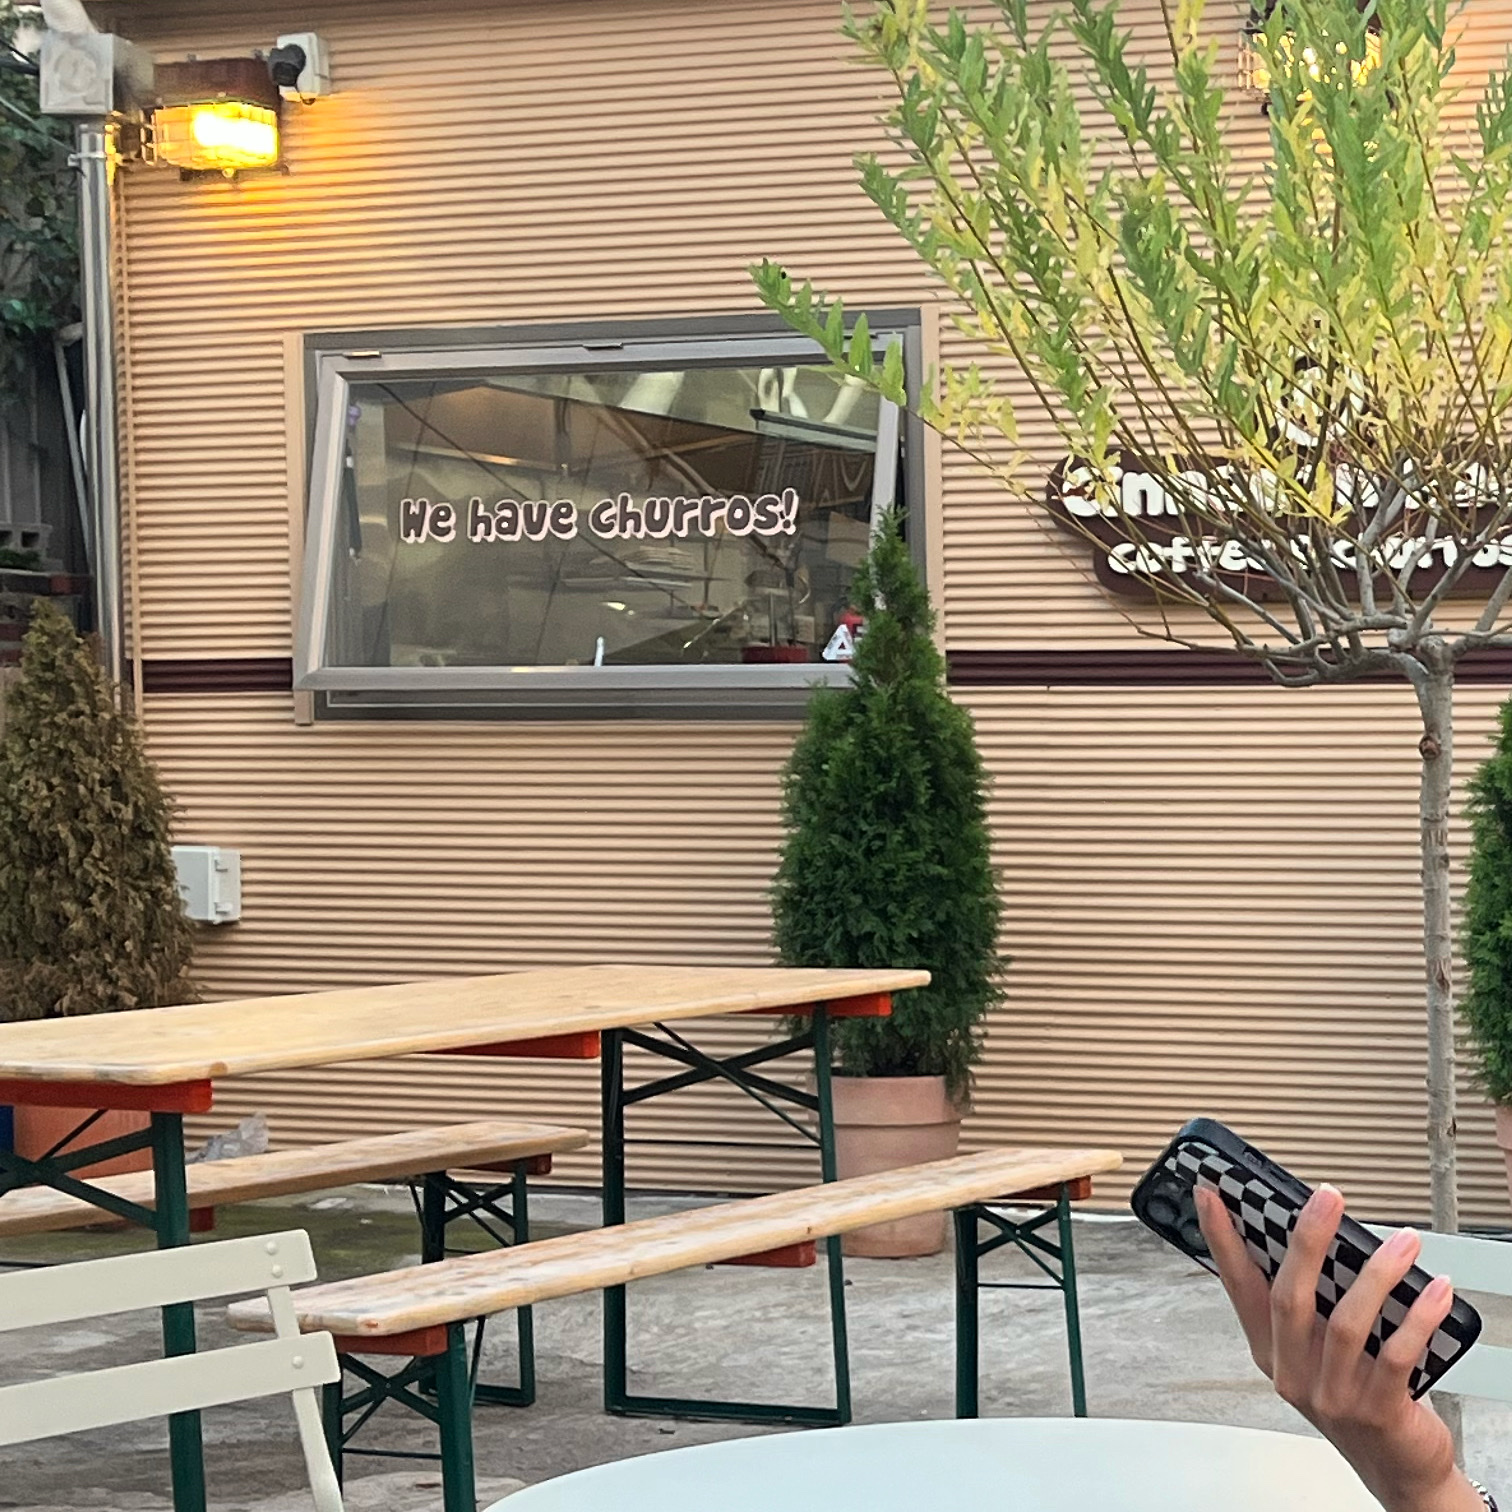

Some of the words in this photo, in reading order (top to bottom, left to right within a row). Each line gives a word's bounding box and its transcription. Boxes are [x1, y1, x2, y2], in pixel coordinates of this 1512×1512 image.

[400, 498, 457, 544] We
[467, 497, 579, 544] have
[588, 487, 800, 540] churros!
